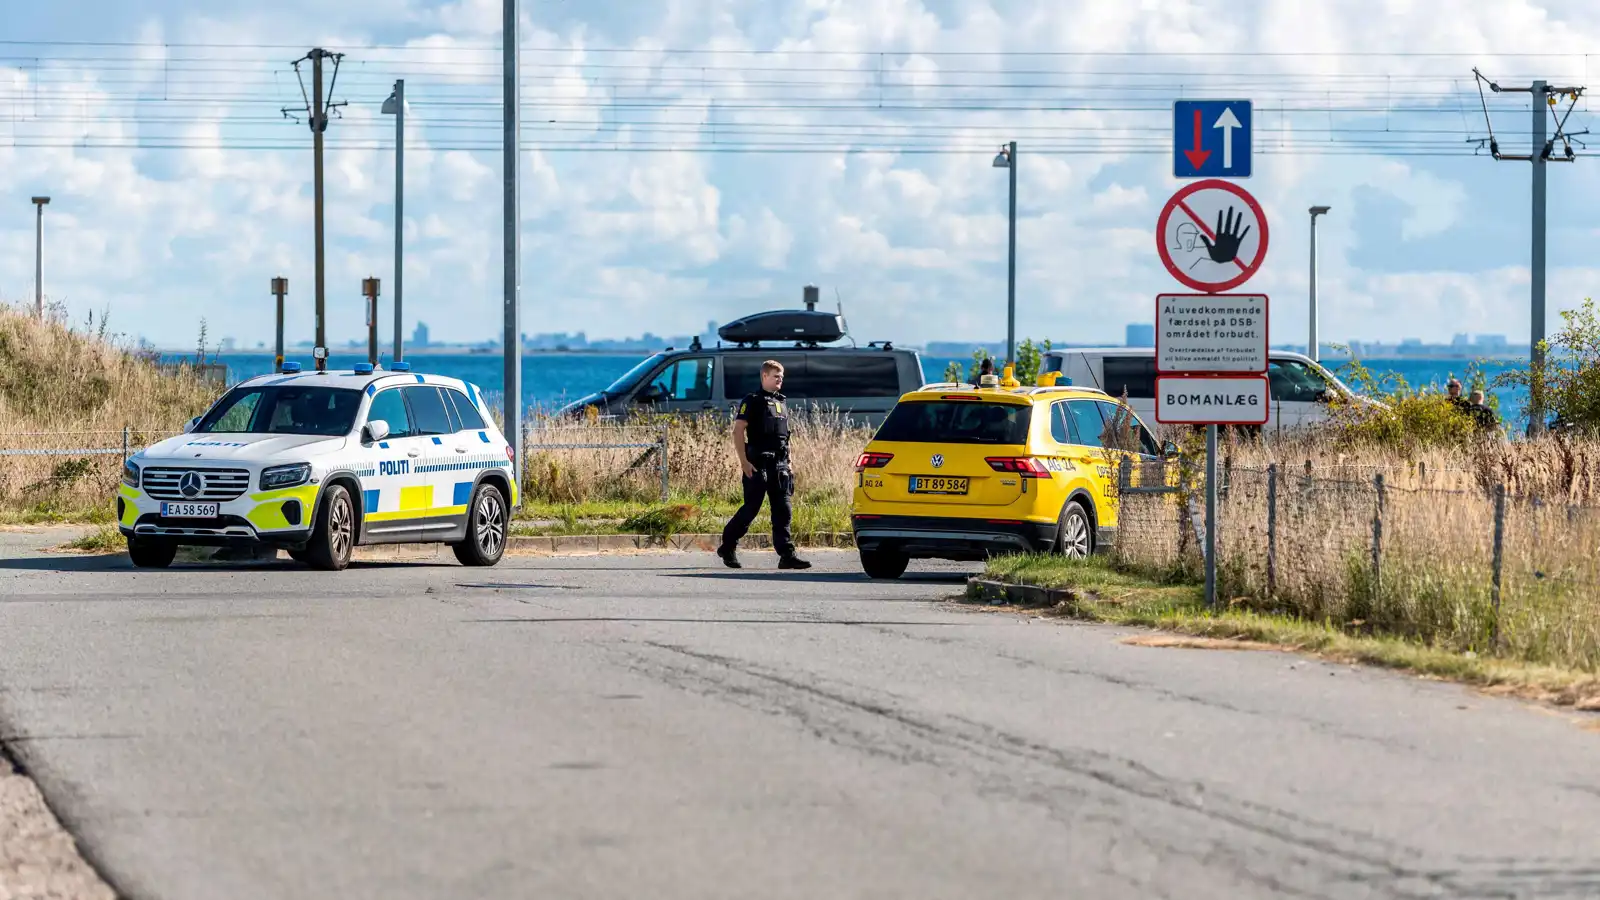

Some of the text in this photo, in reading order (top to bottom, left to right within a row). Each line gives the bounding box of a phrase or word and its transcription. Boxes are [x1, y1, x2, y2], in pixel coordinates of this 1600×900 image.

[1164, 306, 1261, 314] Al uvedkommende
[1169, 318, 1257, 327] færdsel på DSB-
[1166, 330, 1259, 338] området forbudt.
[1167, 394, 1258, 405] BOMANLÆG
[380, 460, 409, 475] POLITI
[916, 479, 966, 490] BT 89 584
[168, 504, 215, 516] EA 58 569
